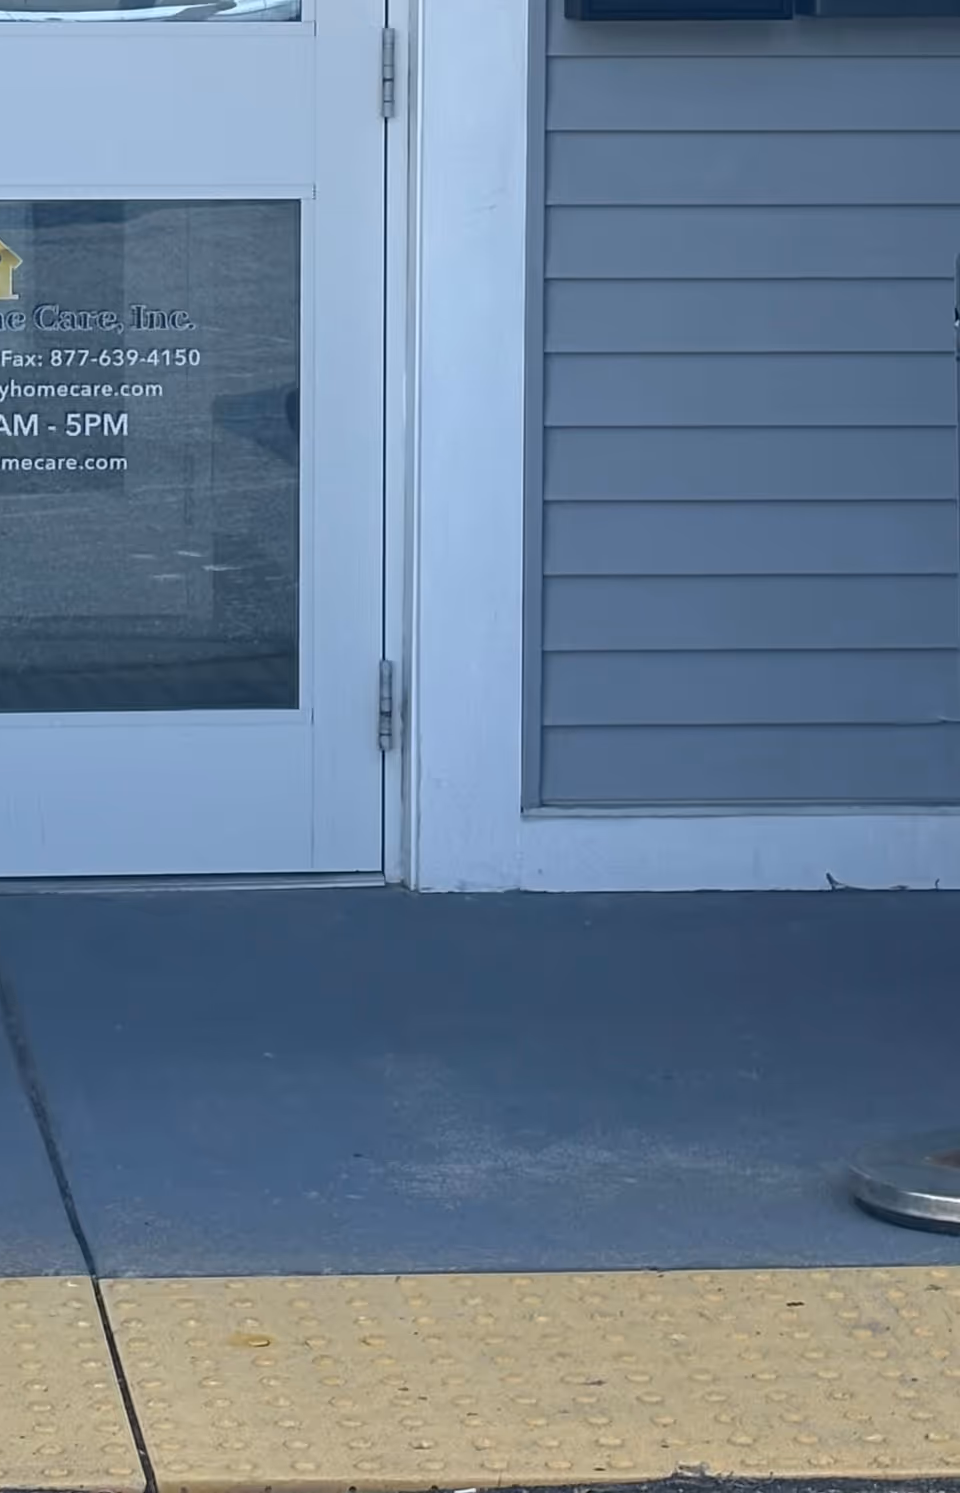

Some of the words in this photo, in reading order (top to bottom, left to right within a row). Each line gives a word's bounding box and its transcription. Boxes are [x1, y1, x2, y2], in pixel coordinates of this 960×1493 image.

[34, 305, 123, 336] Care,
[133, 305, 196, 332] Inc.
[0, 349, 43, 368] Fax:
[50, 349, 201, 368] 877-639-4150
[66, 413, 129, 437] 5PM
